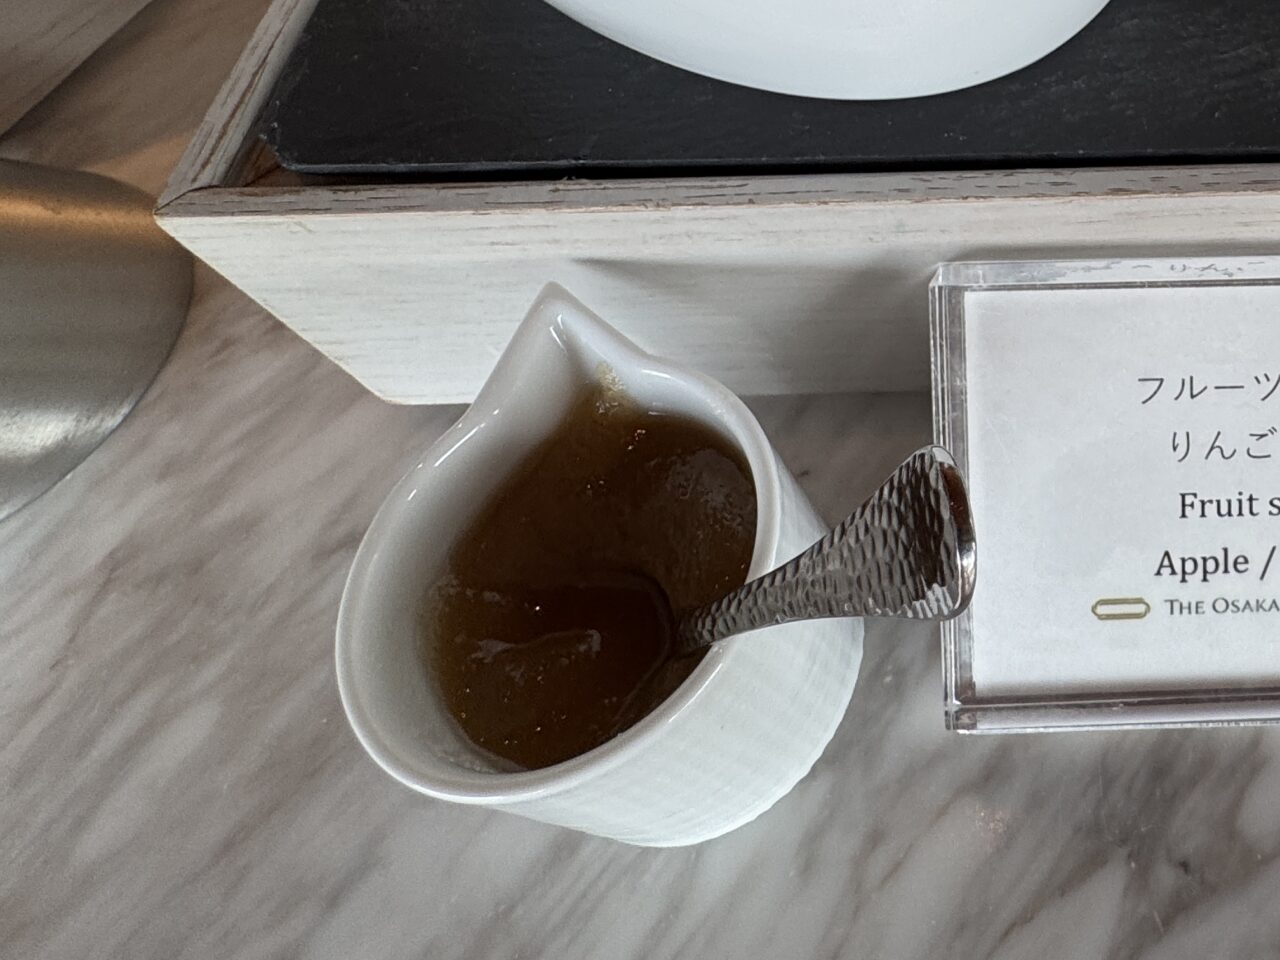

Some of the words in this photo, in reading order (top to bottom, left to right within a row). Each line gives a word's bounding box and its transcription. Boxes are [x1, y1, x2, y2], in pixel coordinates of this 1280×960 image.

[1171, 425, 1278, 463] りんご
[1178, 490, 1260, 519] Fruit
[1153, 546, 1250, 584] Apple
[1258, 544, 1278, 582] /
[1163, 597, 1206, 616] THE
[1211, 595, 1280, 615] OSAKA
